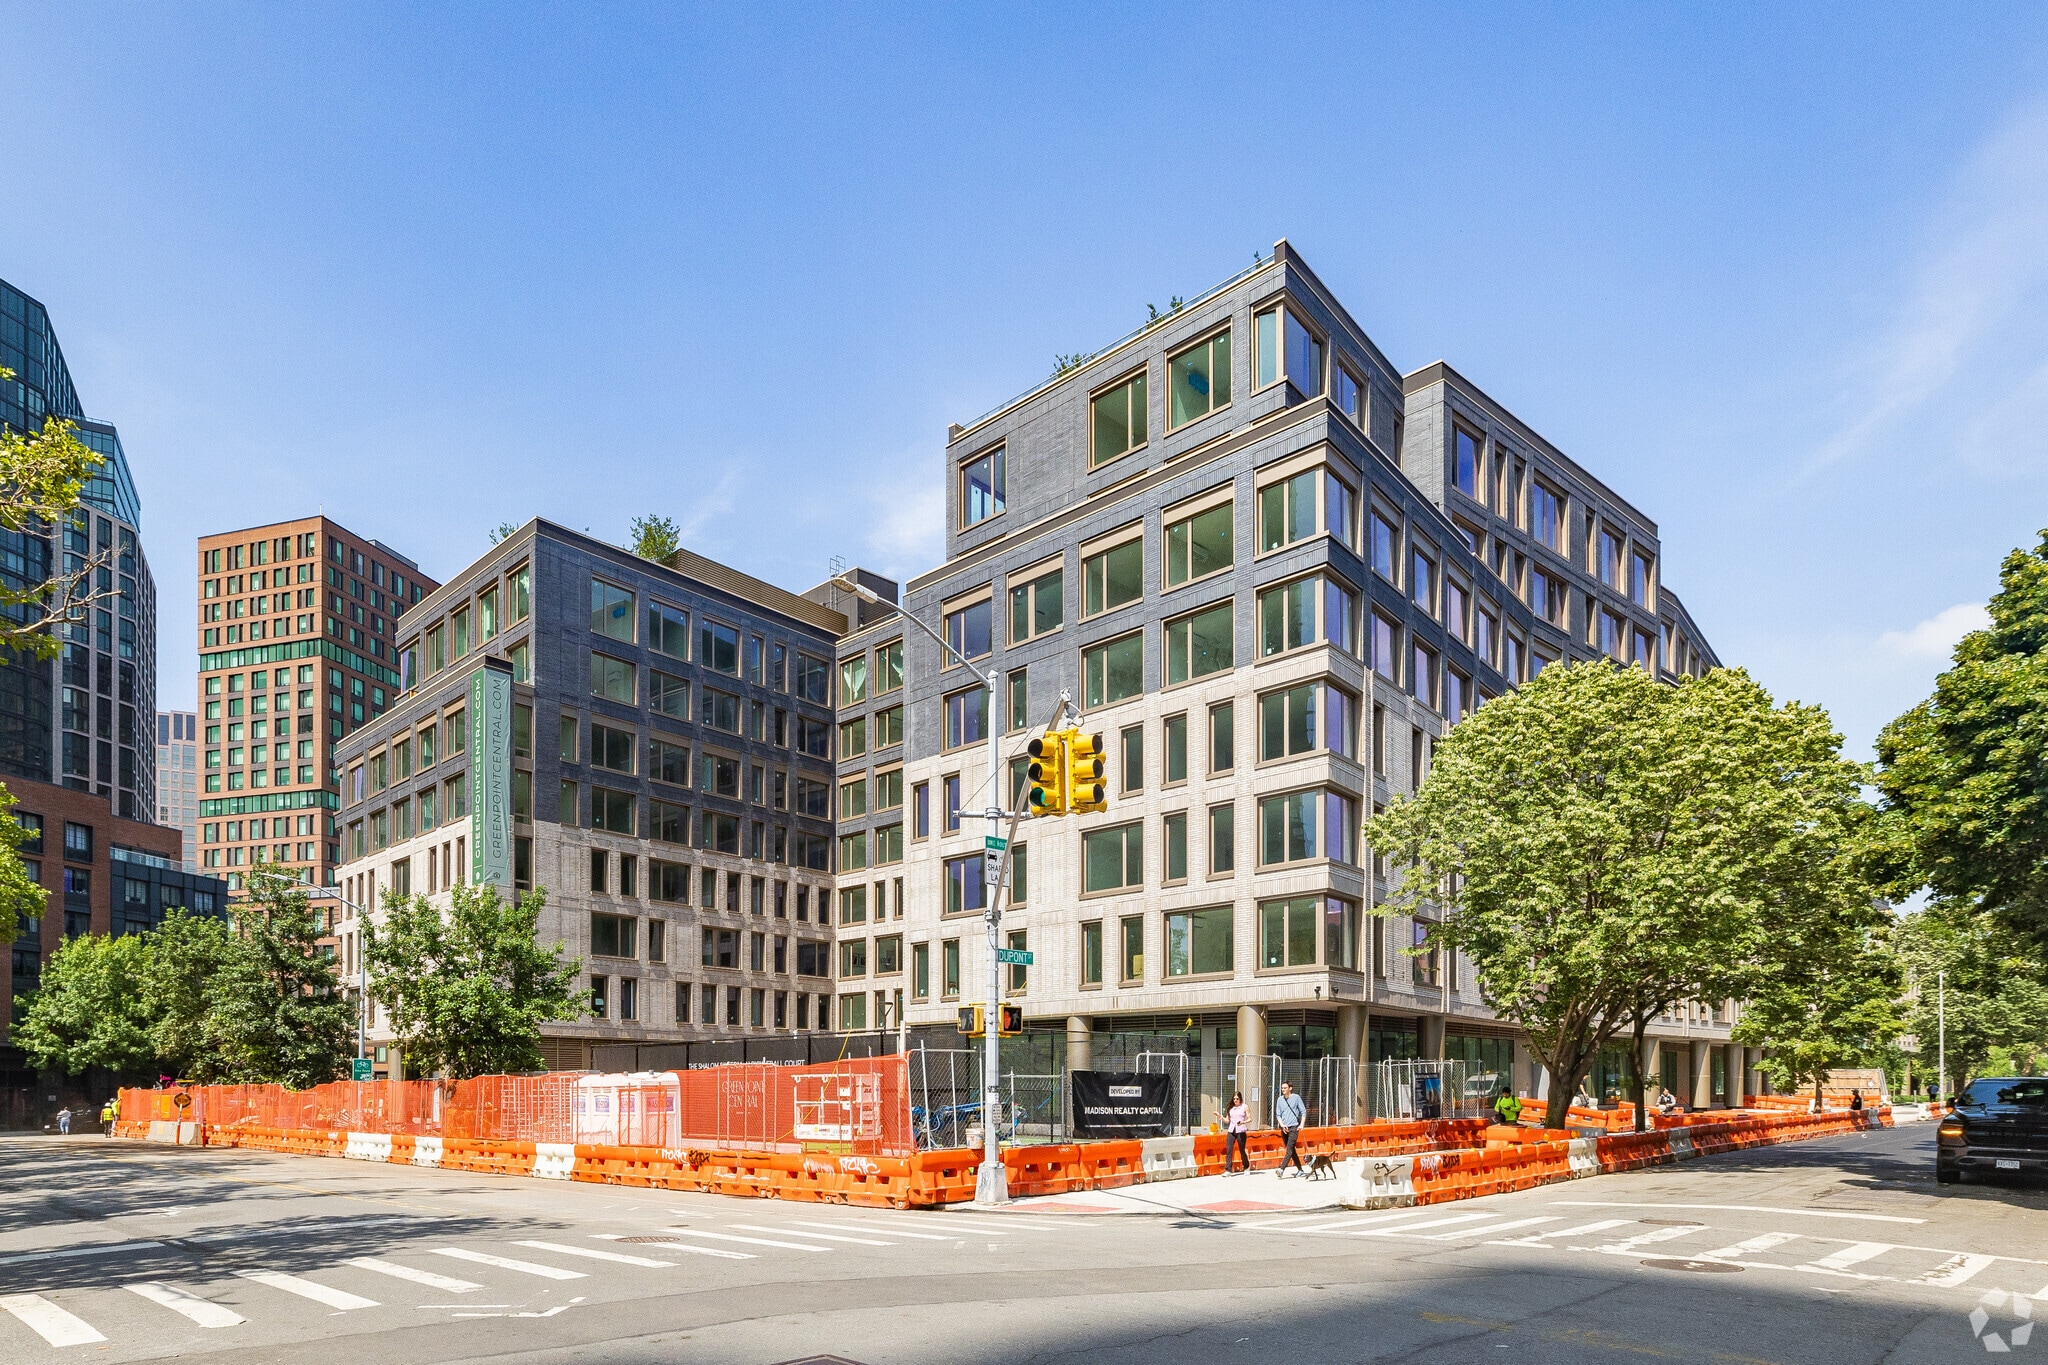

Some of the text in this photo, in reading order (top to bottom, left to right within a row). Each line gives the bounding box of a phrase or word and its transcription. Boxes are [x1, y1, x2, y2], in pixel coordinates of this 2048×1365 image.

[493, 679, 502, 859] GREENPOINTCENTRAL.COM
[987, 863, 1009, 874] SHARD
[999, 950, 1028, 963] DUPONT
[1084, 1106, 1163, 1115] MADISON REALTY CAPITAL
